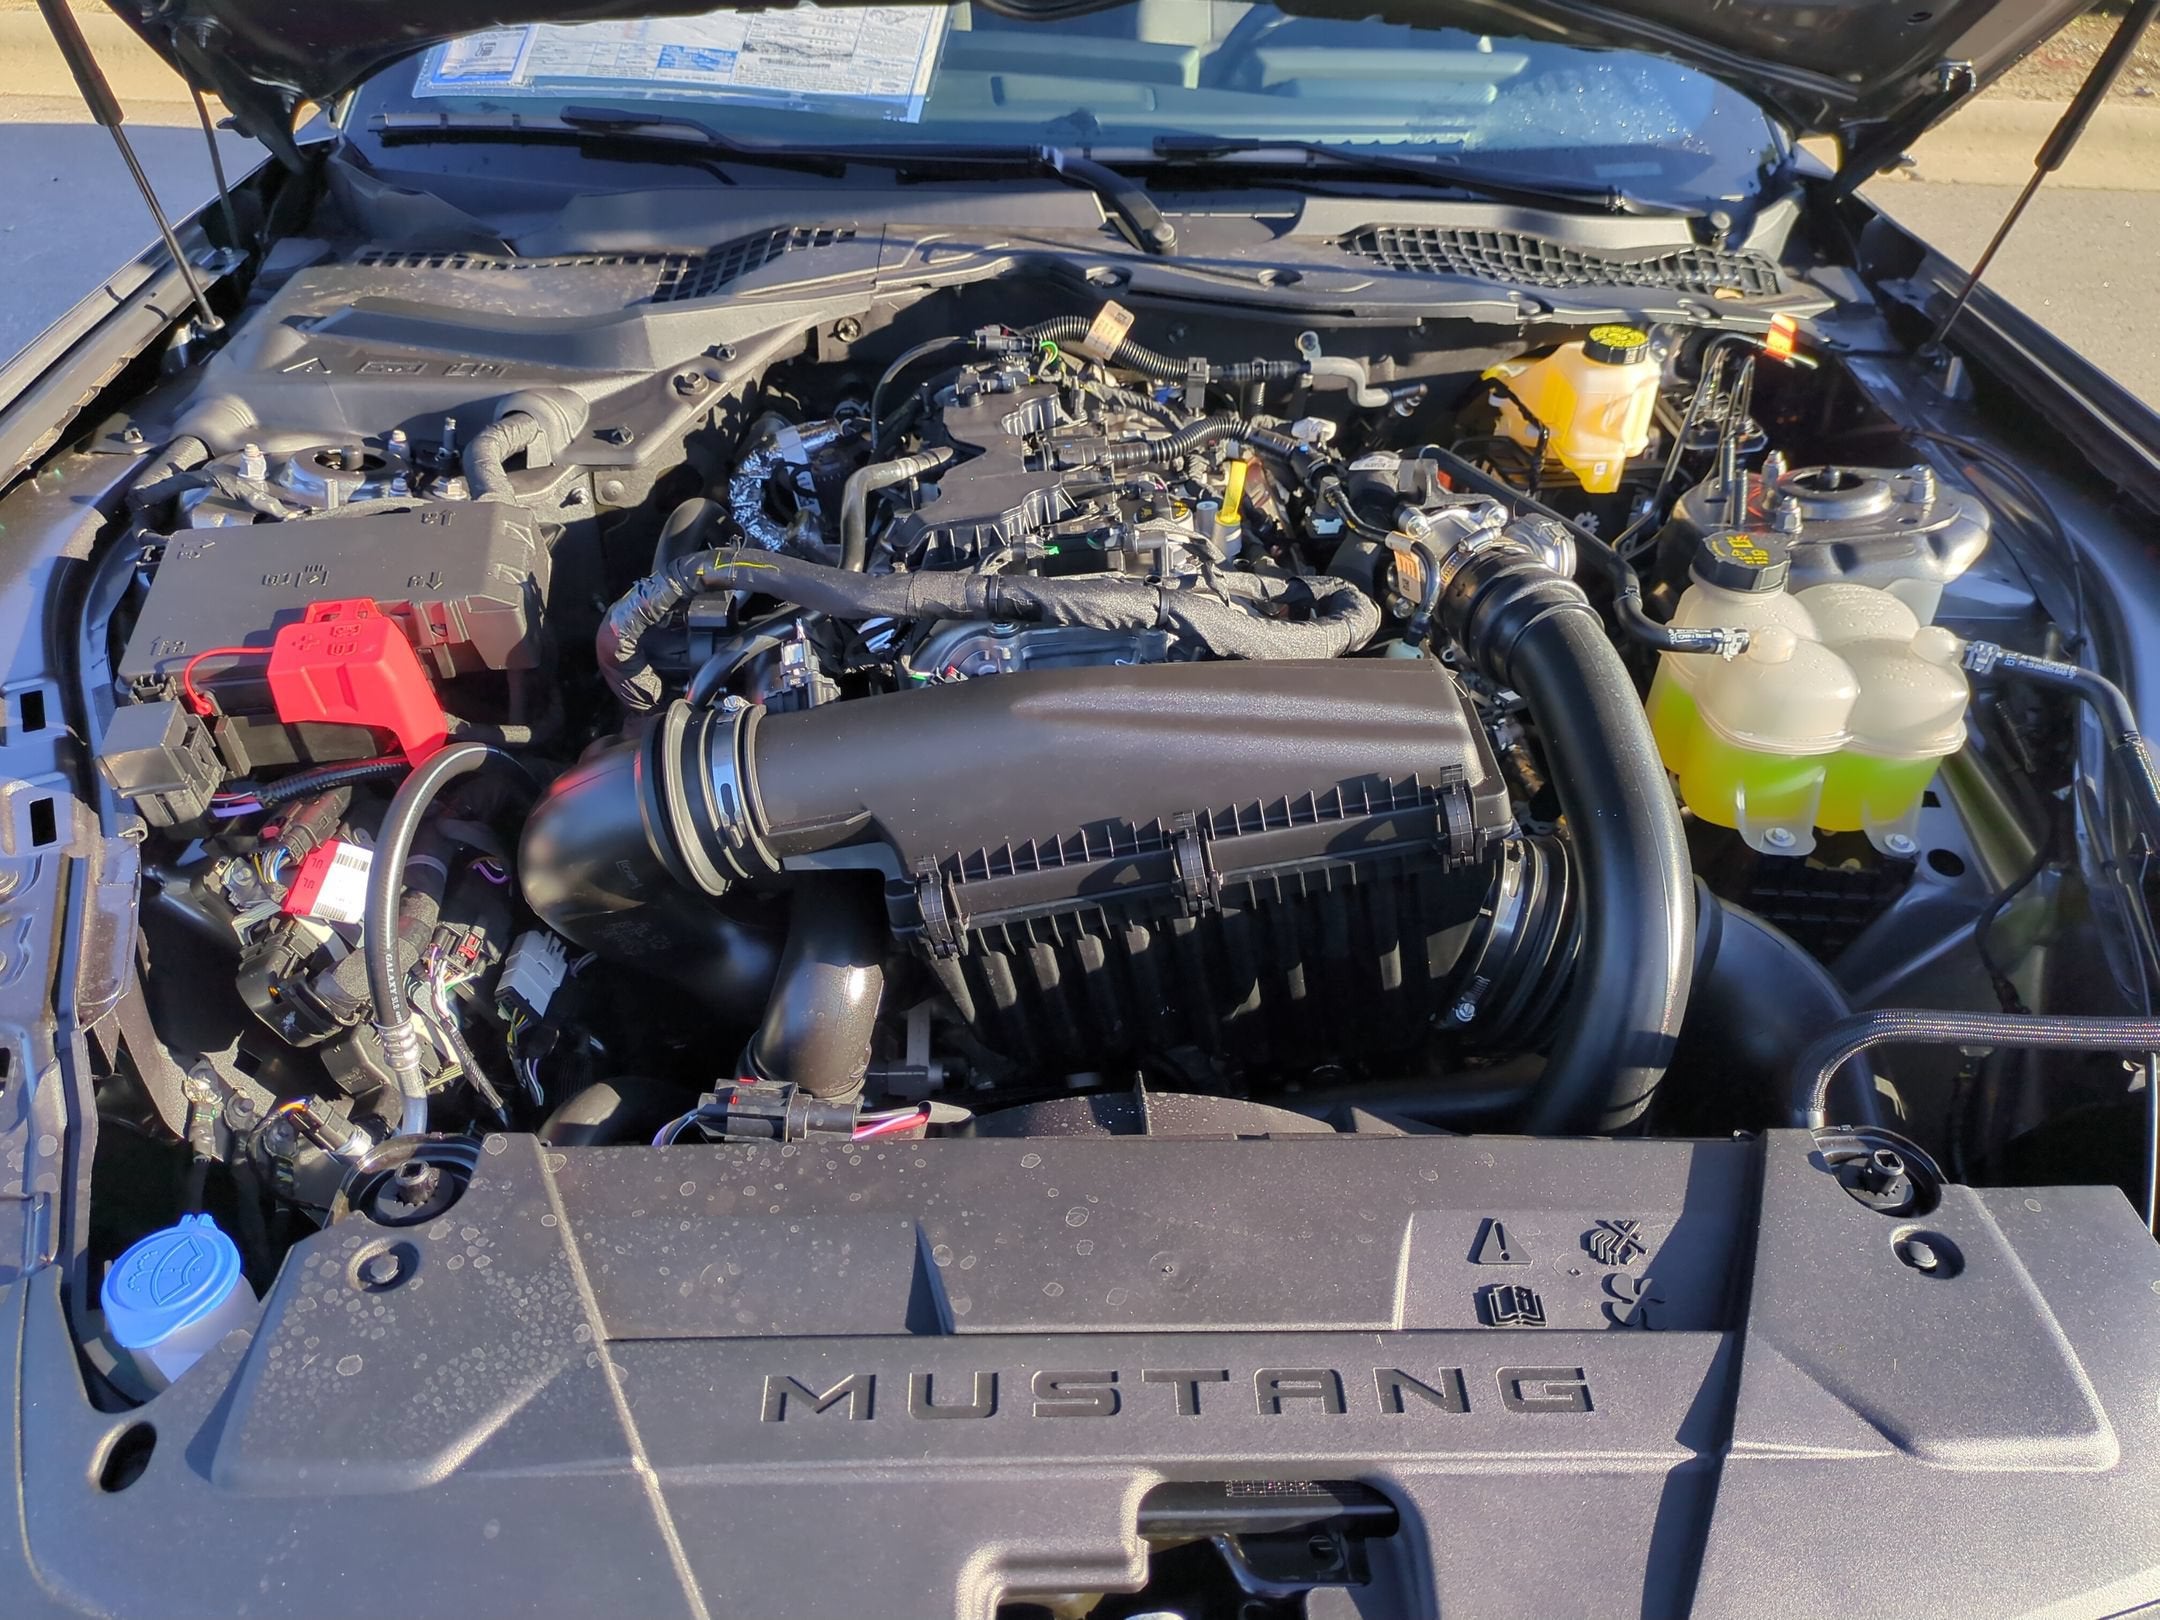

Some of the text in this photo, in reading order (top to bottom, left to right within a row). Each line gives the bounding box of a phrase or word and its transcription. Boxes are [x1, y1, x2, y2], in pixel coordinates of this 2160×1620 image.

[303, 877, 316, 889] UL
[385, 953, 398, 996] GALAXY
[761, 1366, 1595, 1422] MUSTANG
